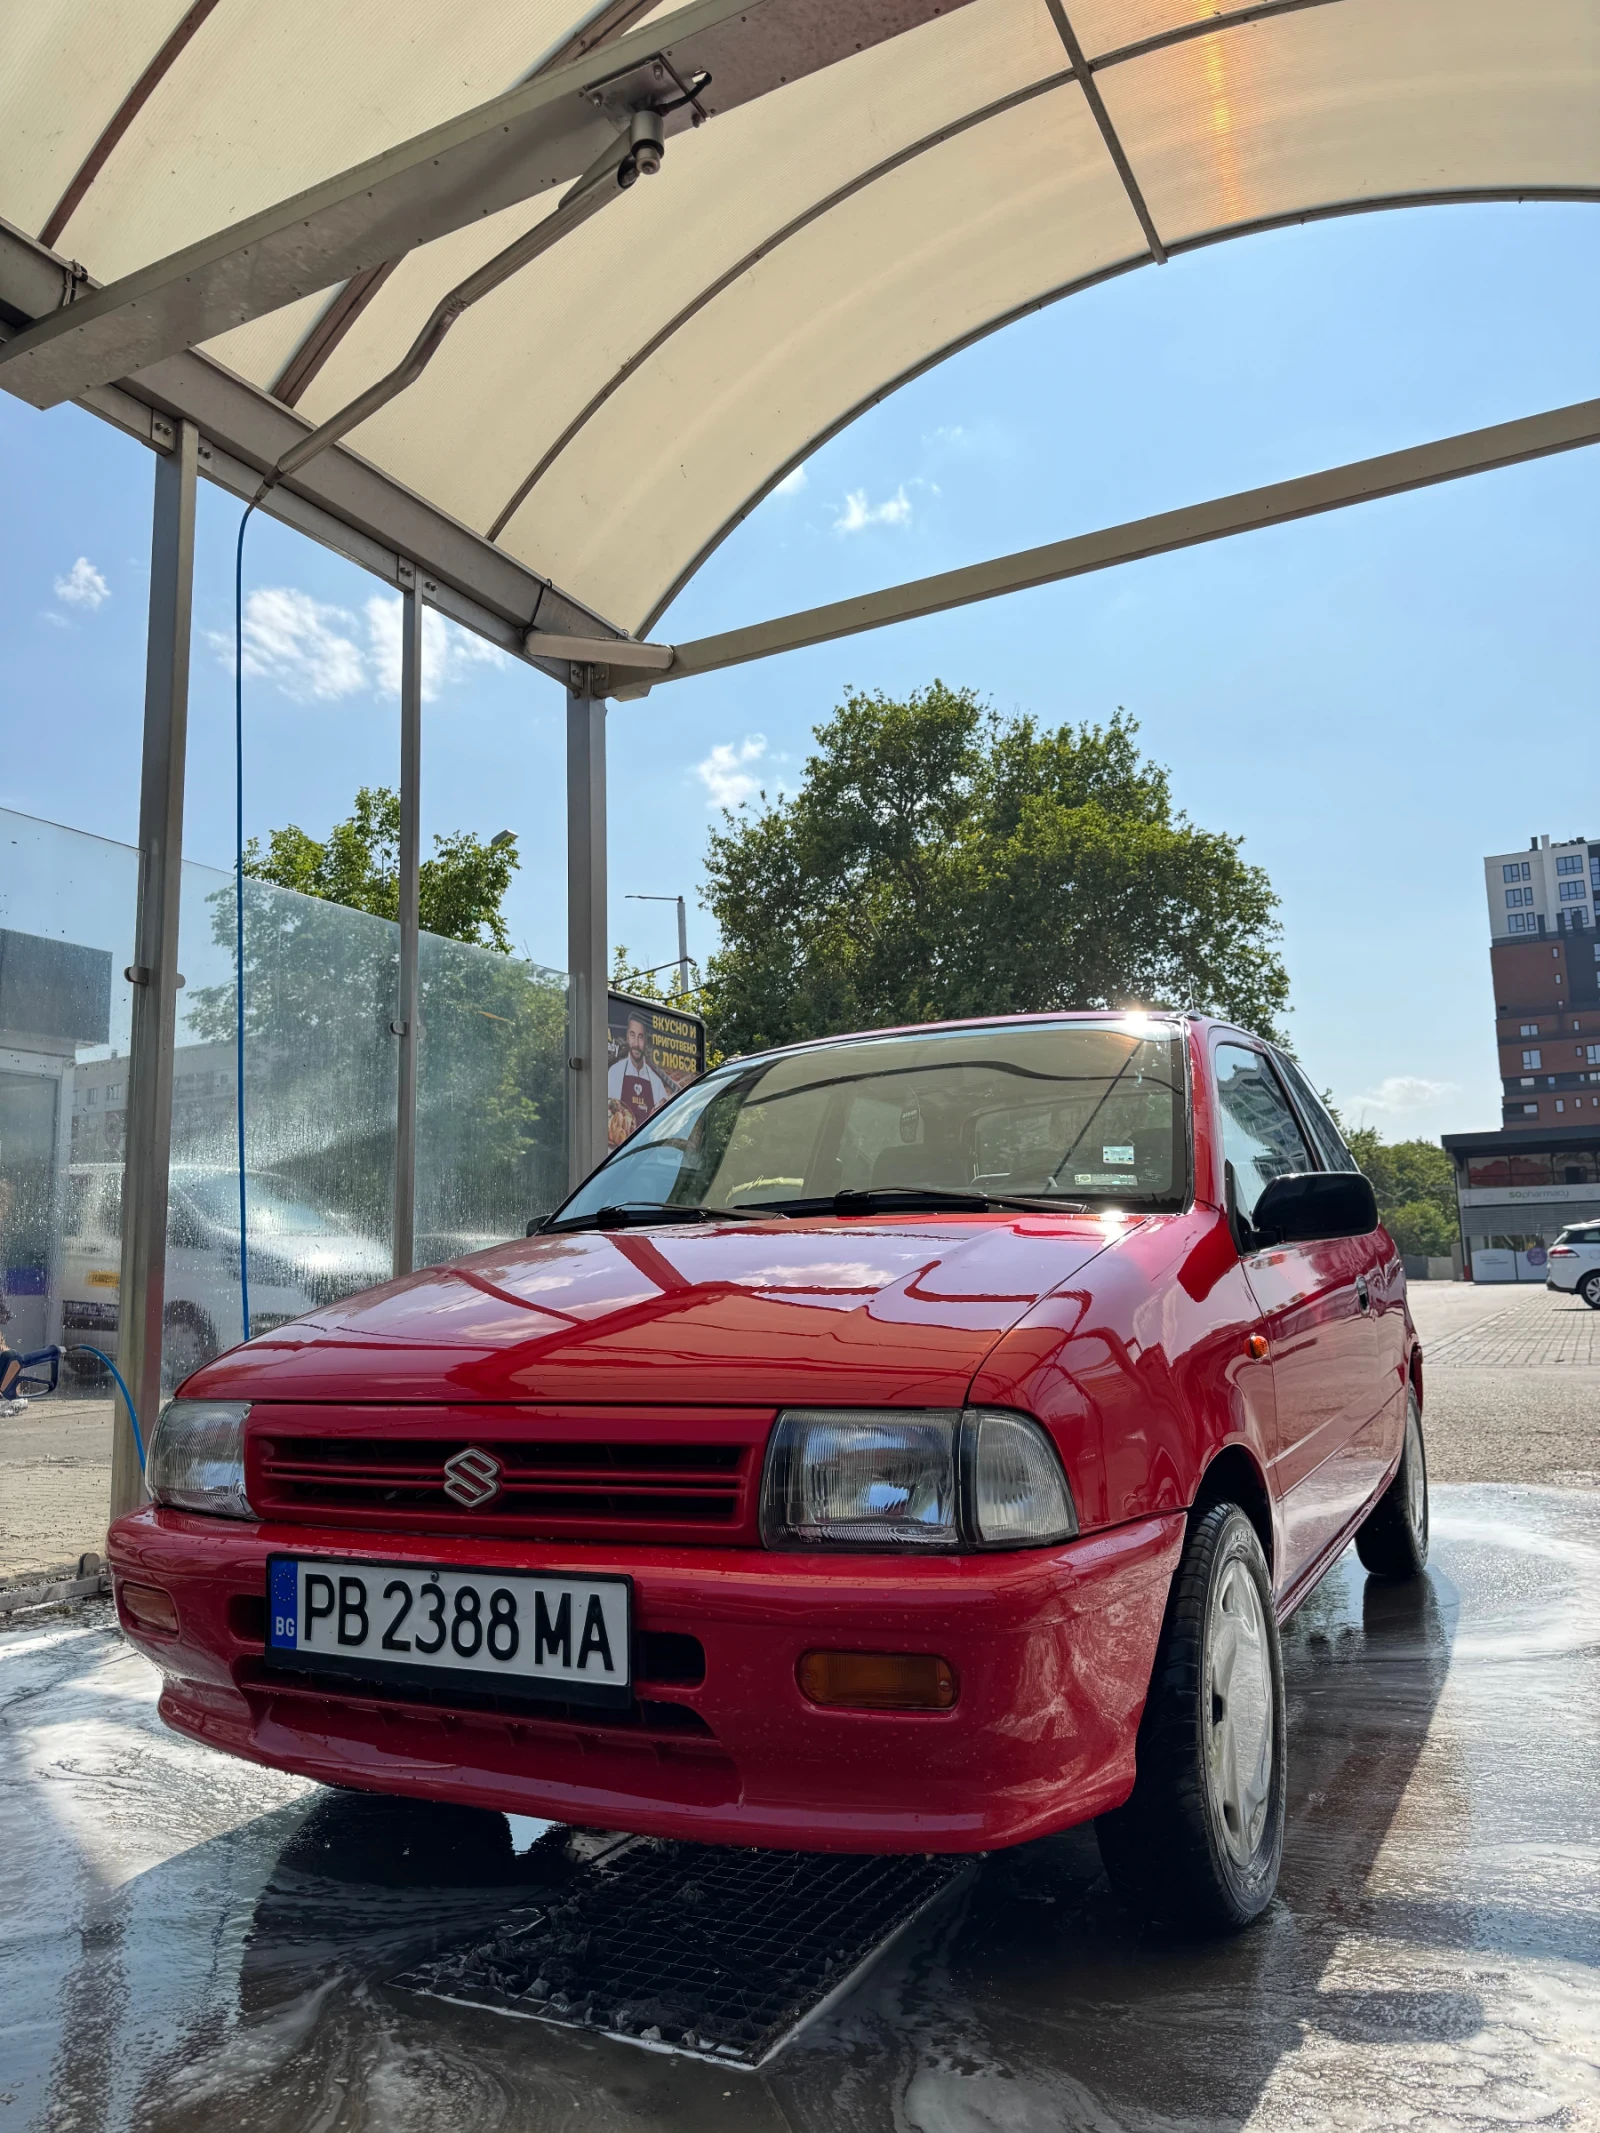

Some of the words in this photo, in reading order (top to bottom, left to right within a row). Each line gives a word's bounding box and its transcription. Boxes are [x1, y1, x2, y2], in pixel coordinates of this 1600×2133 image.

[652, 1015, 688, 1037] ВКУСНО
[690, 1025, 696, 1039] И
[652, 1034, 697, 1055] ПРИГОТВЕНО
[653, 1049, 660, 1065] С
[275, 1616, 295, 1636] BG
[304, 1573, 369, 1646] PB
[382, 1580, 519, 1661] 2388
[535, 1590, 614, 1671] MA
